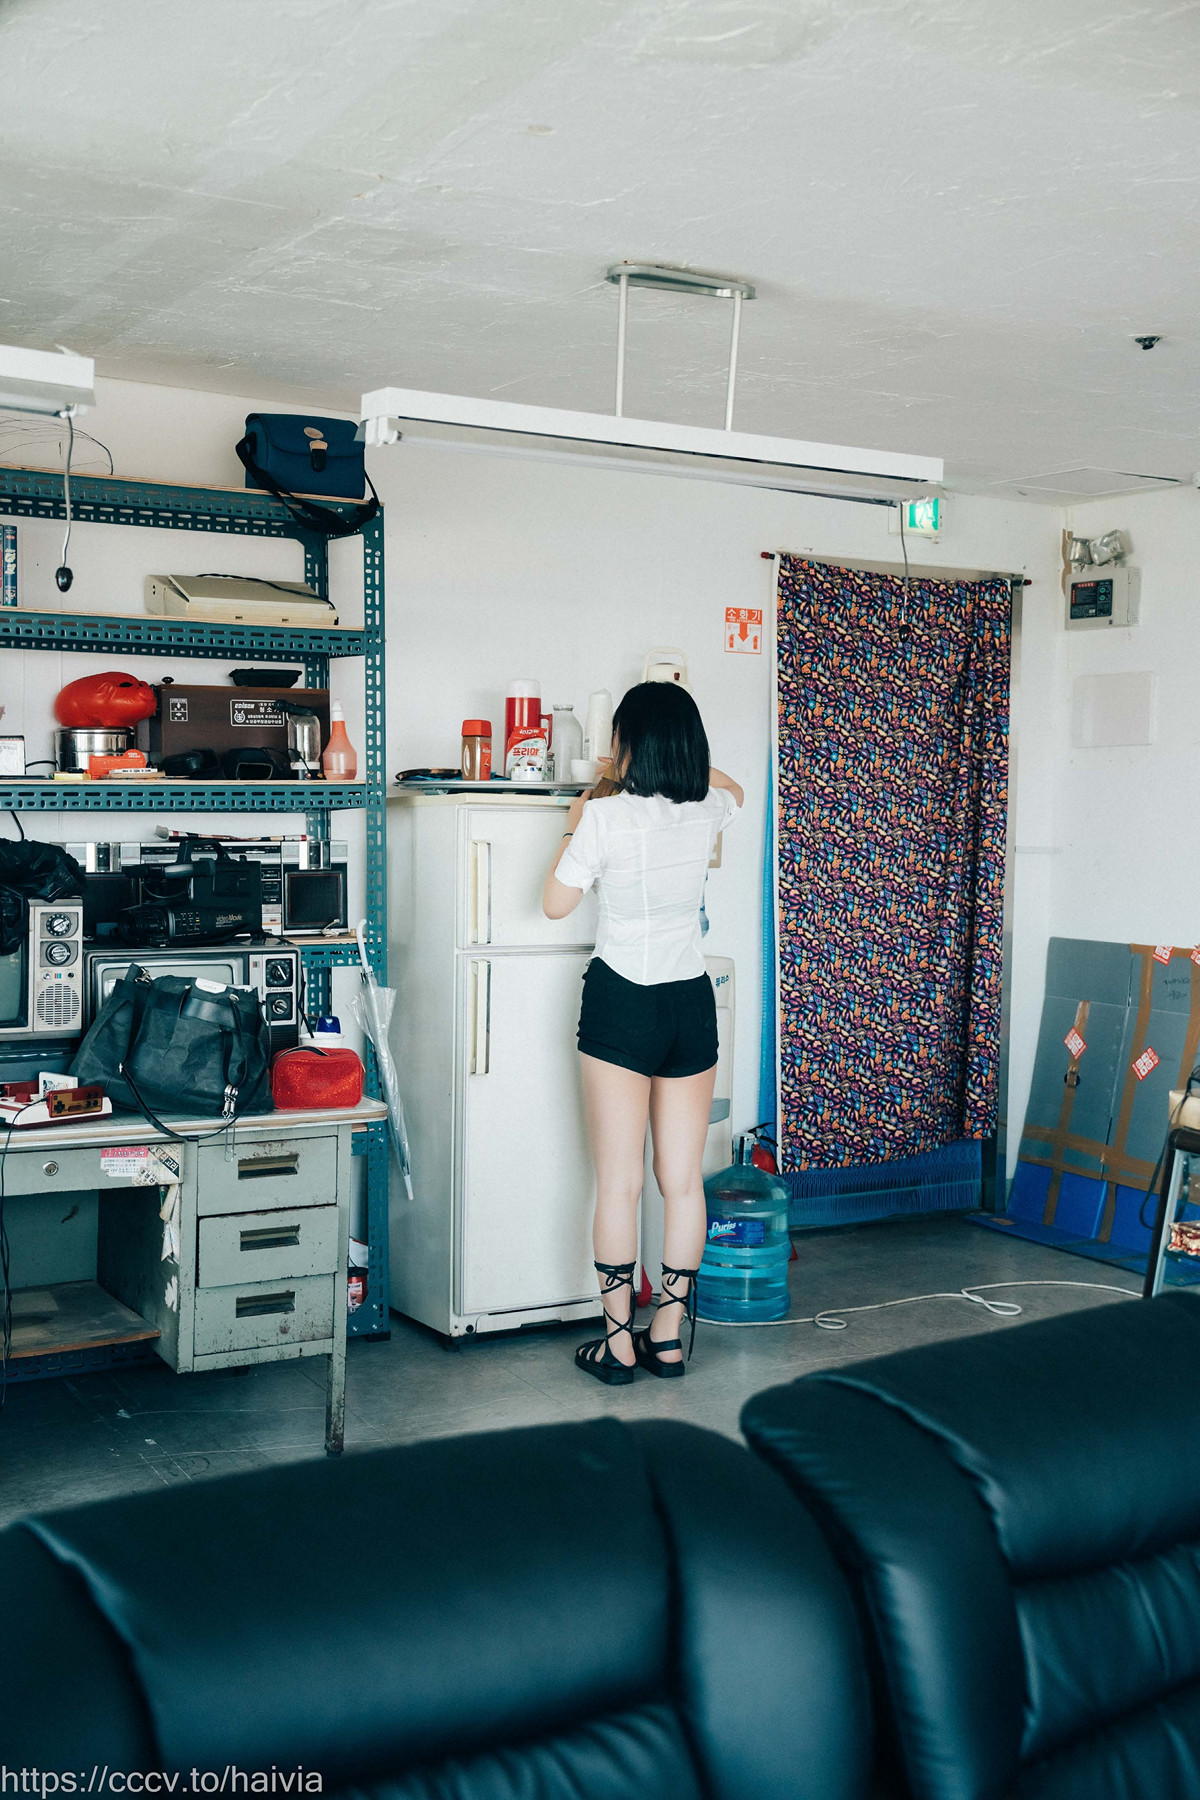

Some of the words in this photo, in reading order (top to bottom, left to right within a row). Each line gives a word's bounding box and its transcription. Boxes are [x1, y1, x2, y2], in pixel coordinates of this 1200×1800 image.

[727, 609, 760, 620] 소화기
[512, 747, 540, 756] 프리마
[711, 1220, 737, 1234] Puriss
